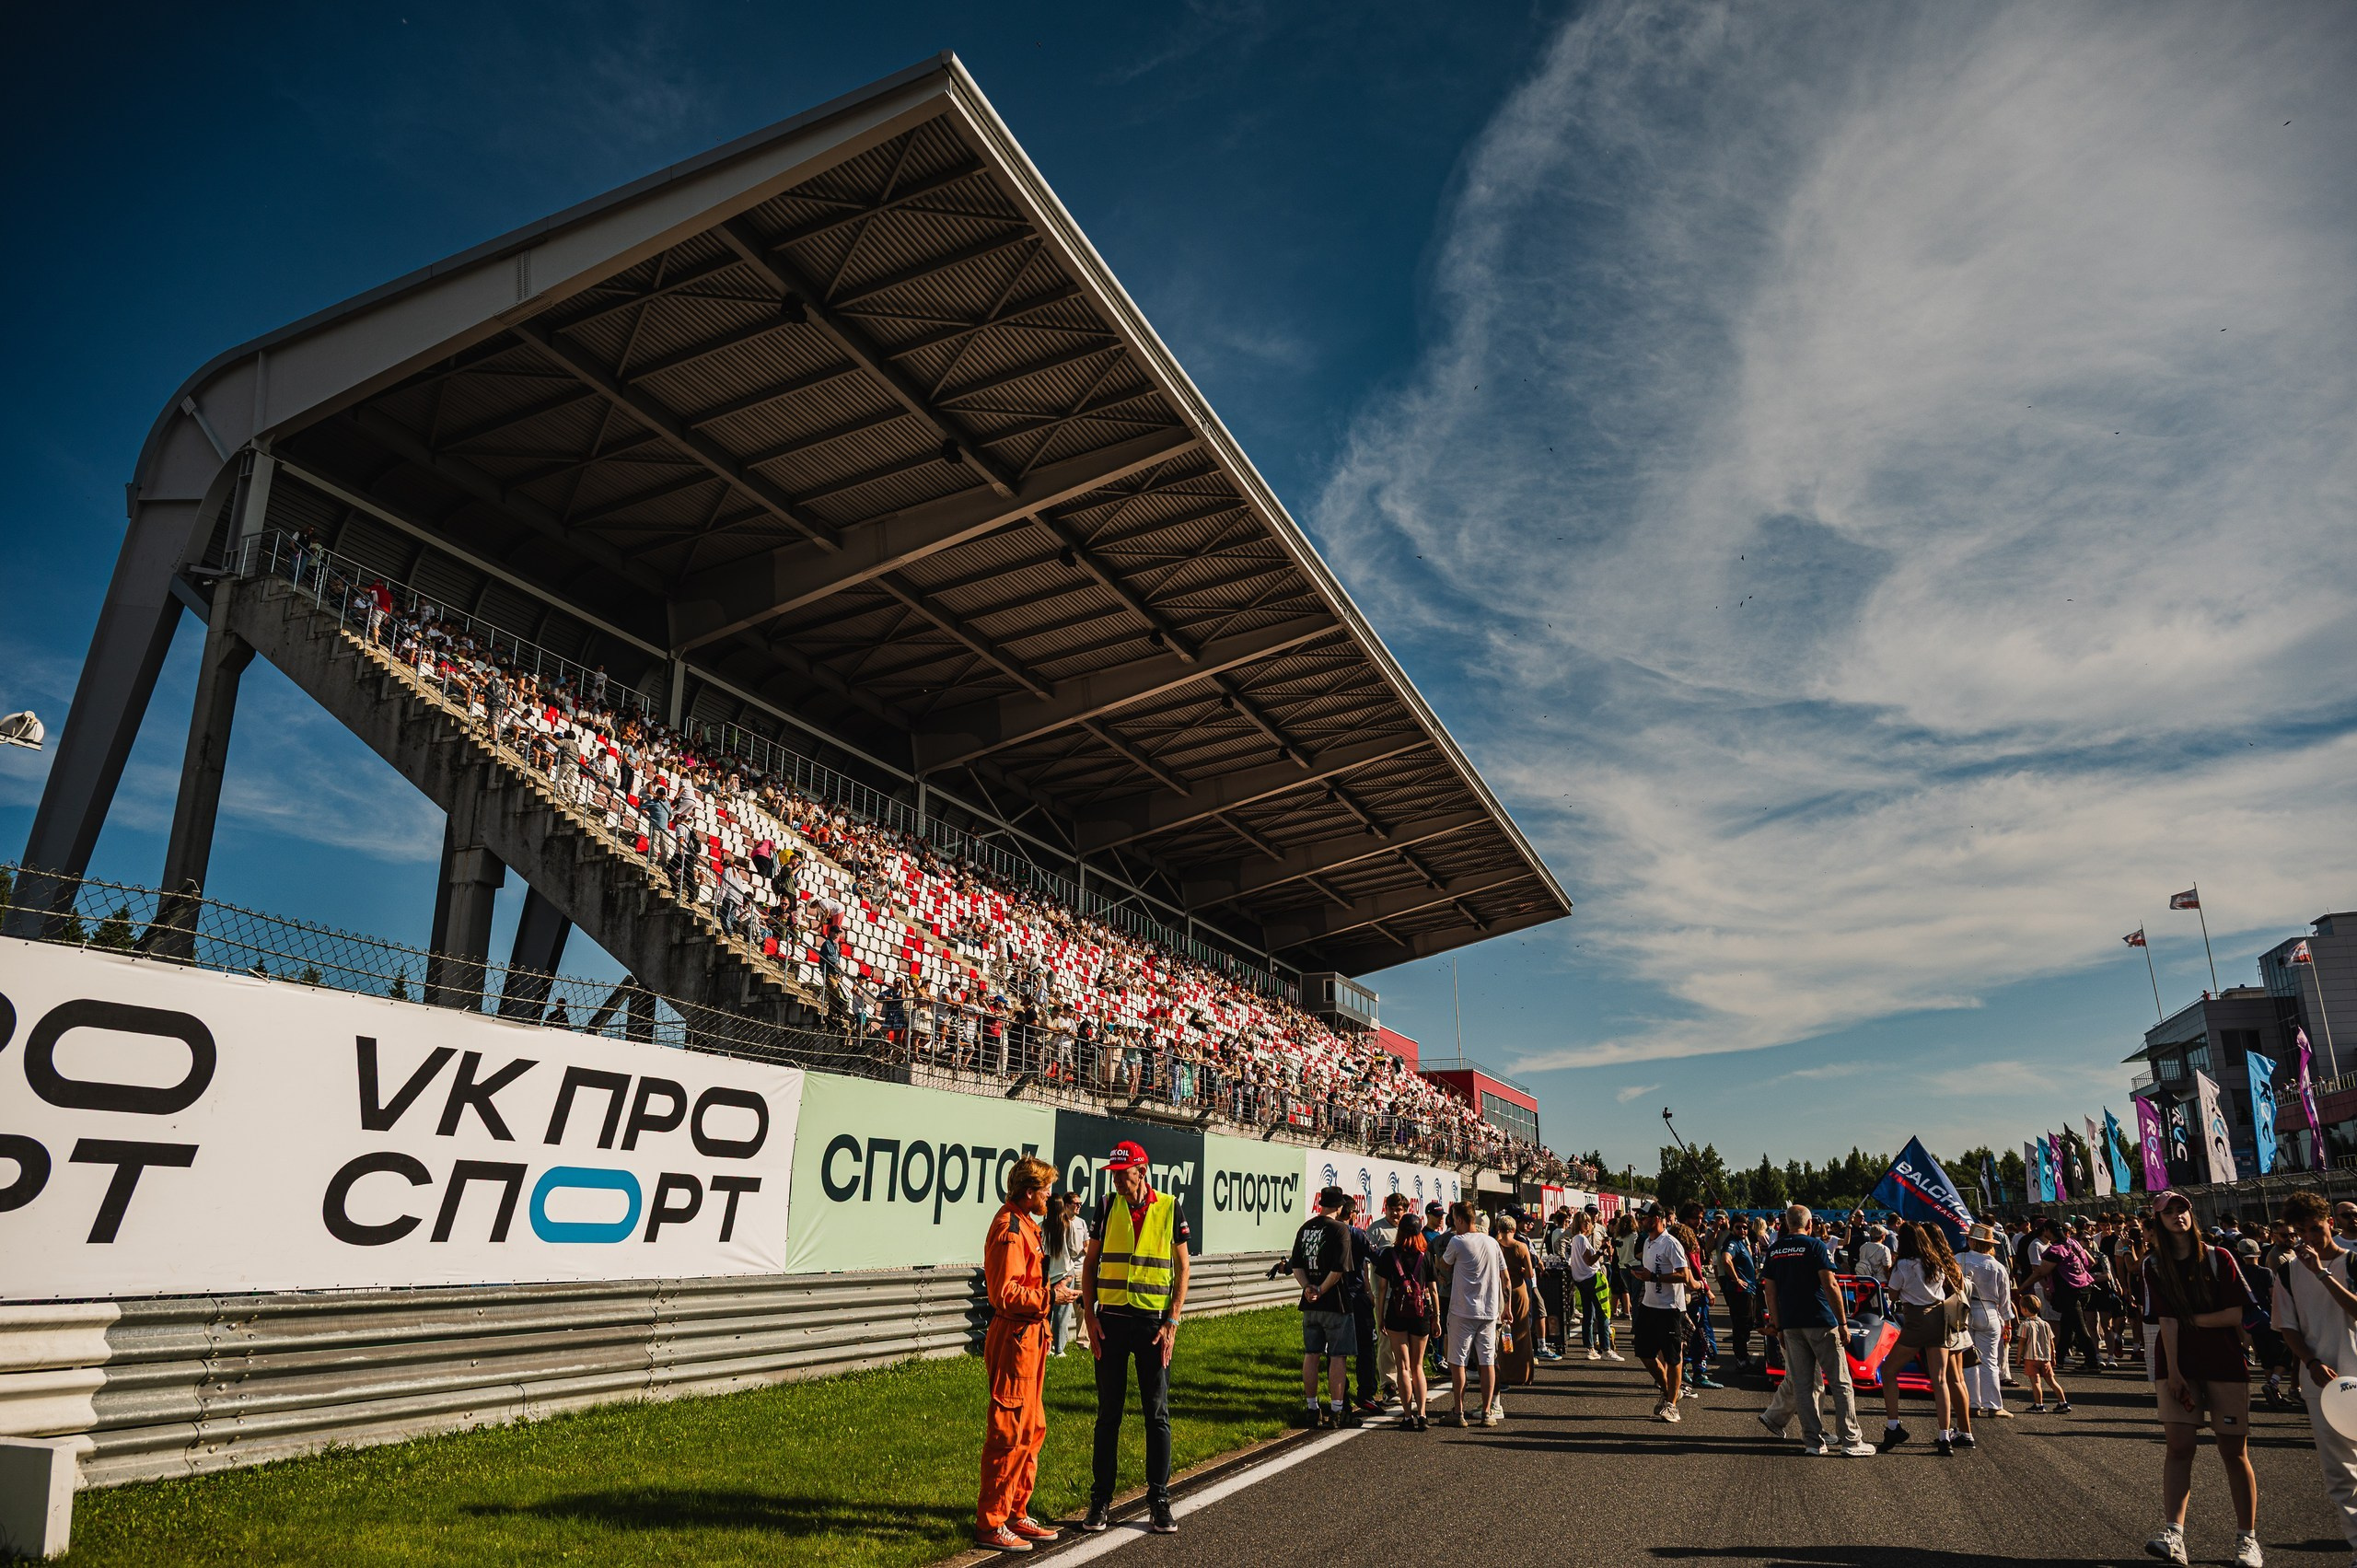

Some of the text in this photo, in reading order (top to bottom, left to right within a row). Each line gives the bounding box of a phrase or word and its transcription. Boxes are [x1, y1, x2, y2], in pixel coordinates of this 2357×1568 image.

[356, 1035, 770, 1159] VK ПРО
[323, 1151, 761, 1246] СПОРТ
